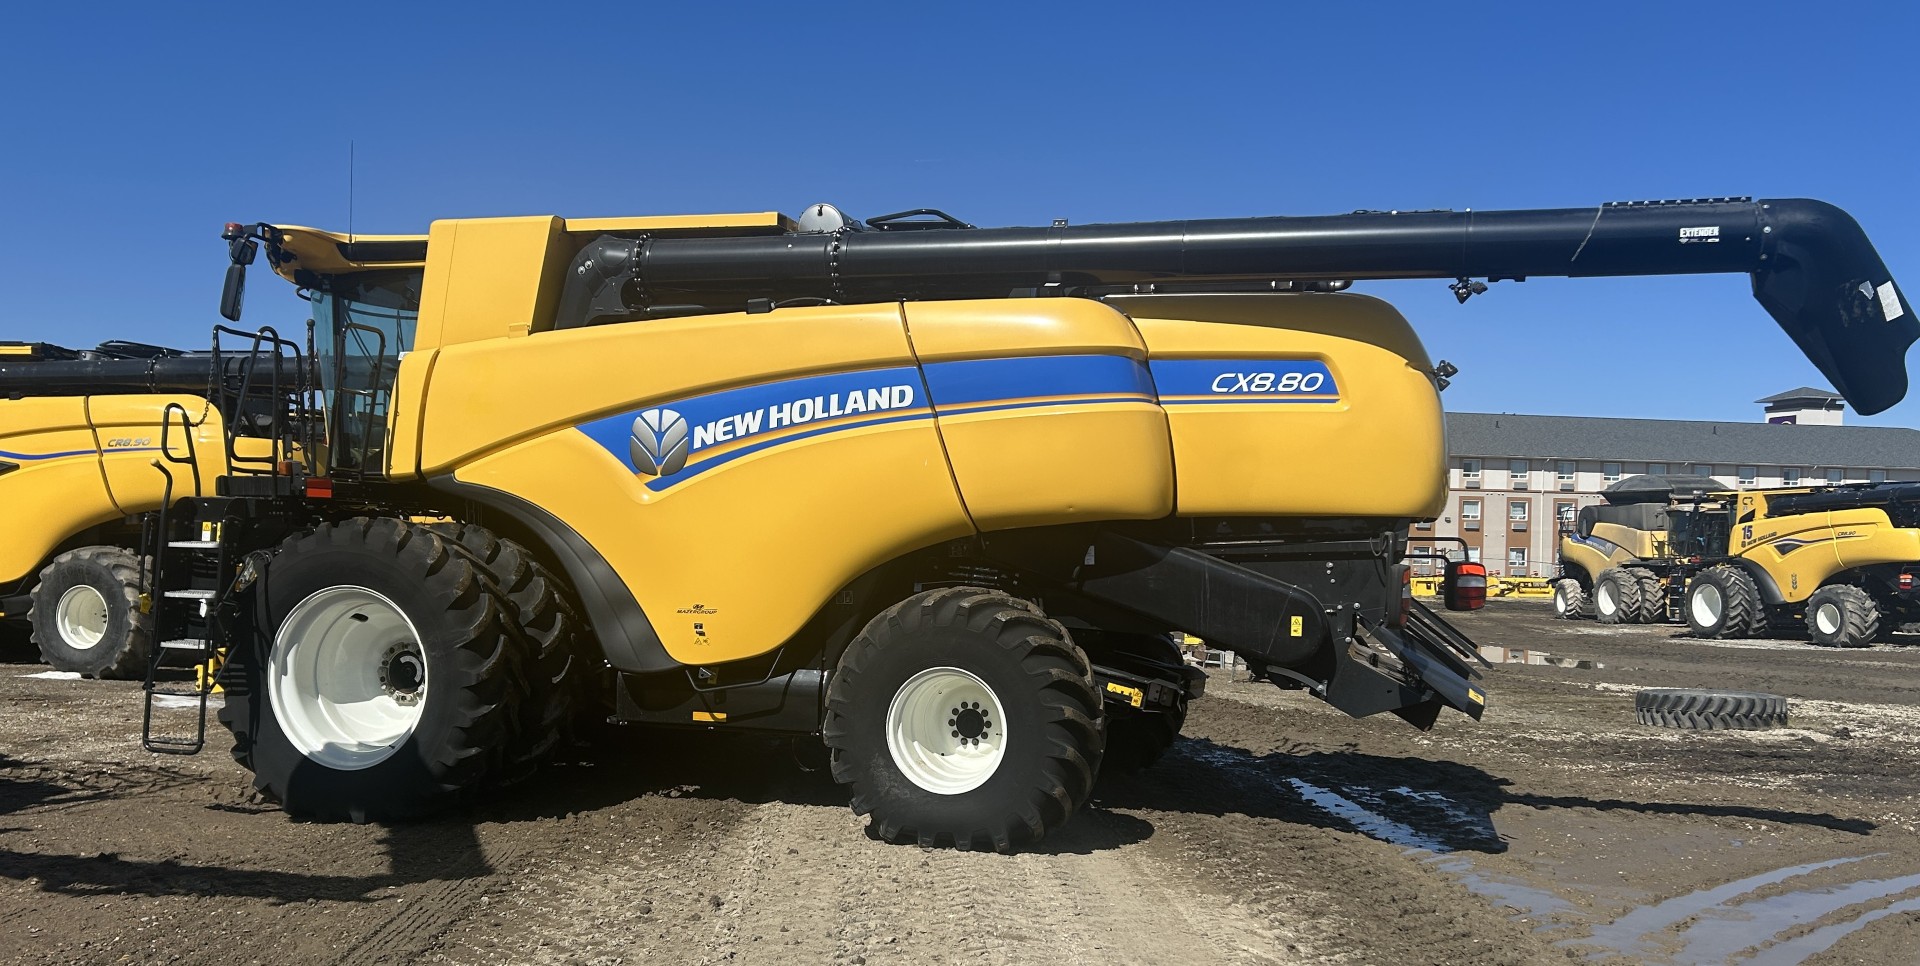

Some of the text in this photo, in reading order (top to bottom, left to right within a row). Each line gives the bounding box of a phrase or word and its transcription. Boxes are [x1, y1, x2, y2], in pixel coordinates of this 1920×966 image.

[1680, 226, 1719, 237] EXTENDER
[1211, 372, 1324, 393] CX8.80
[693, 384, 914, 450] NEW HOLLAND
[107, 438, 151, 447] CR8.90
[1742, 525, 1753, 540] 15
[1758, 531, 1777, 542] HOLLAND
